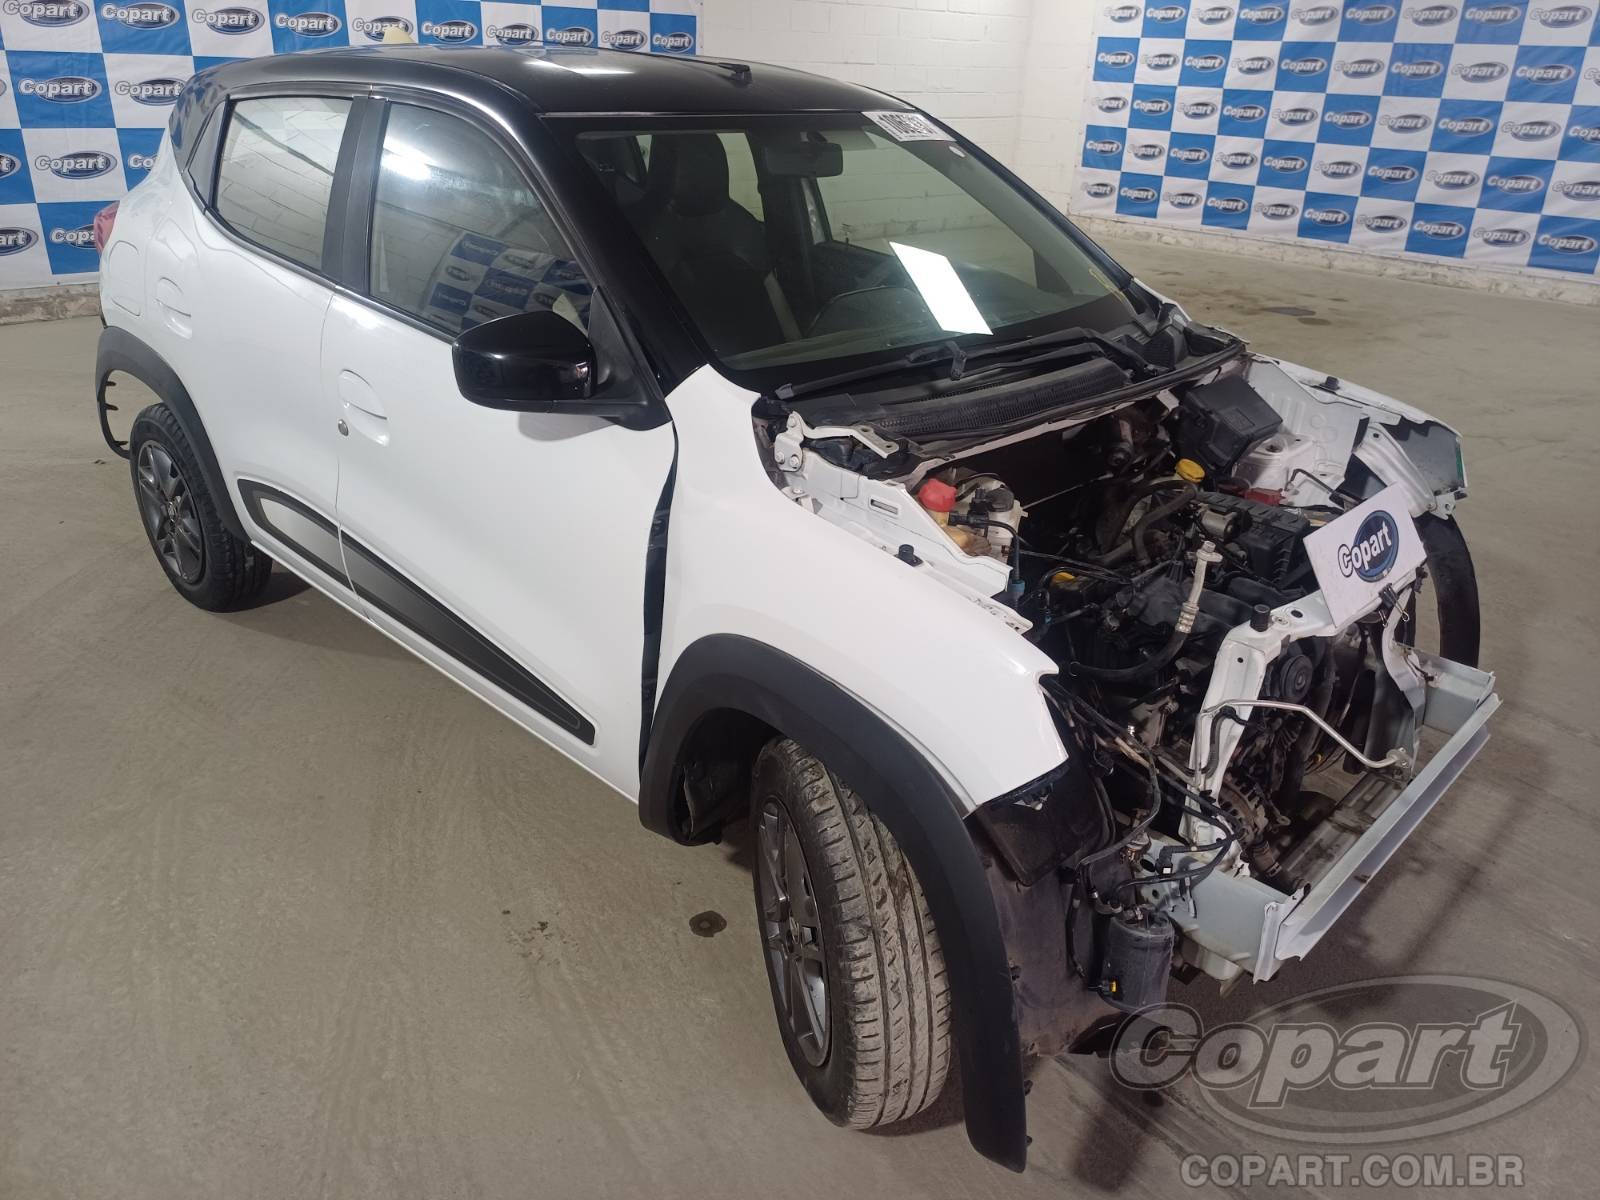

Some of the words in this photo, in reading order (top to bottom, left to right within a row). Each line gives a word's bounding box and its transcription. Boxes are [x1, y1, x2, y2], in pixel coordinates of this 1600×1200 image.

[3, 0, 79, 20] Copart
[102, 4, 171, 24] Copart
[1146, 7, 1183, 20] Copart
[1240, 8, 1280, 21] Copart
[1345, 8, 1389, 21] Copart
[1402, 7, 1449, 21] Copart
[1465, 8, 1515, 22] Copart
[1529, 7, 1584, 22] Copart
[192, 8, 256, 27] Copart
[275, 13, 334, 31] Copart
[421, 21, 472, 38] Copart
[546, 27, 588, 43] Copart
[601, 31, 641, 46] Copart
[652, 34, 690, 48] Copart
[1097, 53, 1131, 64] Copart
[1184, 56, 1222, 69] Copart
[1281, 59, 1322, 72] Copart
[1334, 60, 1377, 74] Copart
[1391, 61, 1437, 75] Copart
[1451, 63, 1500, 77] Copart
[1516, 66, 1567, 79] Copart
[19, 78, 93, 98] Copart
[115, 80, 184, 99] Copart
[1133, 99, 1166, 112] Copart
[1223, 105, 1261, 119] Copart
[1324, 111, 1366, 125] Copart
[1379, 115, 1425, 129] Copart
[1438, 118, 1486, 132] Copart
[1501, 121, 1553, 136] Copart
[1086, 140, 1118, 152] Copart
[1170, 148, 1206, 161] Copart
[35, 155, 106, 174] Copart
[1263, 156, 1302, 169] Copart
[1313, 160, 1356, 175] Copart
[1368, 166, 1413, 180] Copart
[1425, 170, 1473, 185] Copart
[1487, 176, 1537, 190] Copart
[1120, 187, 1154, 200] Copart
[1207, 197, 1243, 211] Copart
[1304, 208, 1345, 223] Copart
[1356, 214, 1400, 229] Copart
[1413, 221, 1460, 235] Copart
[1473, 227, 1524, 242] Copart
[1538, 234, 1593, 250] Copart
[1338, 520, 1392, 578] Copart
